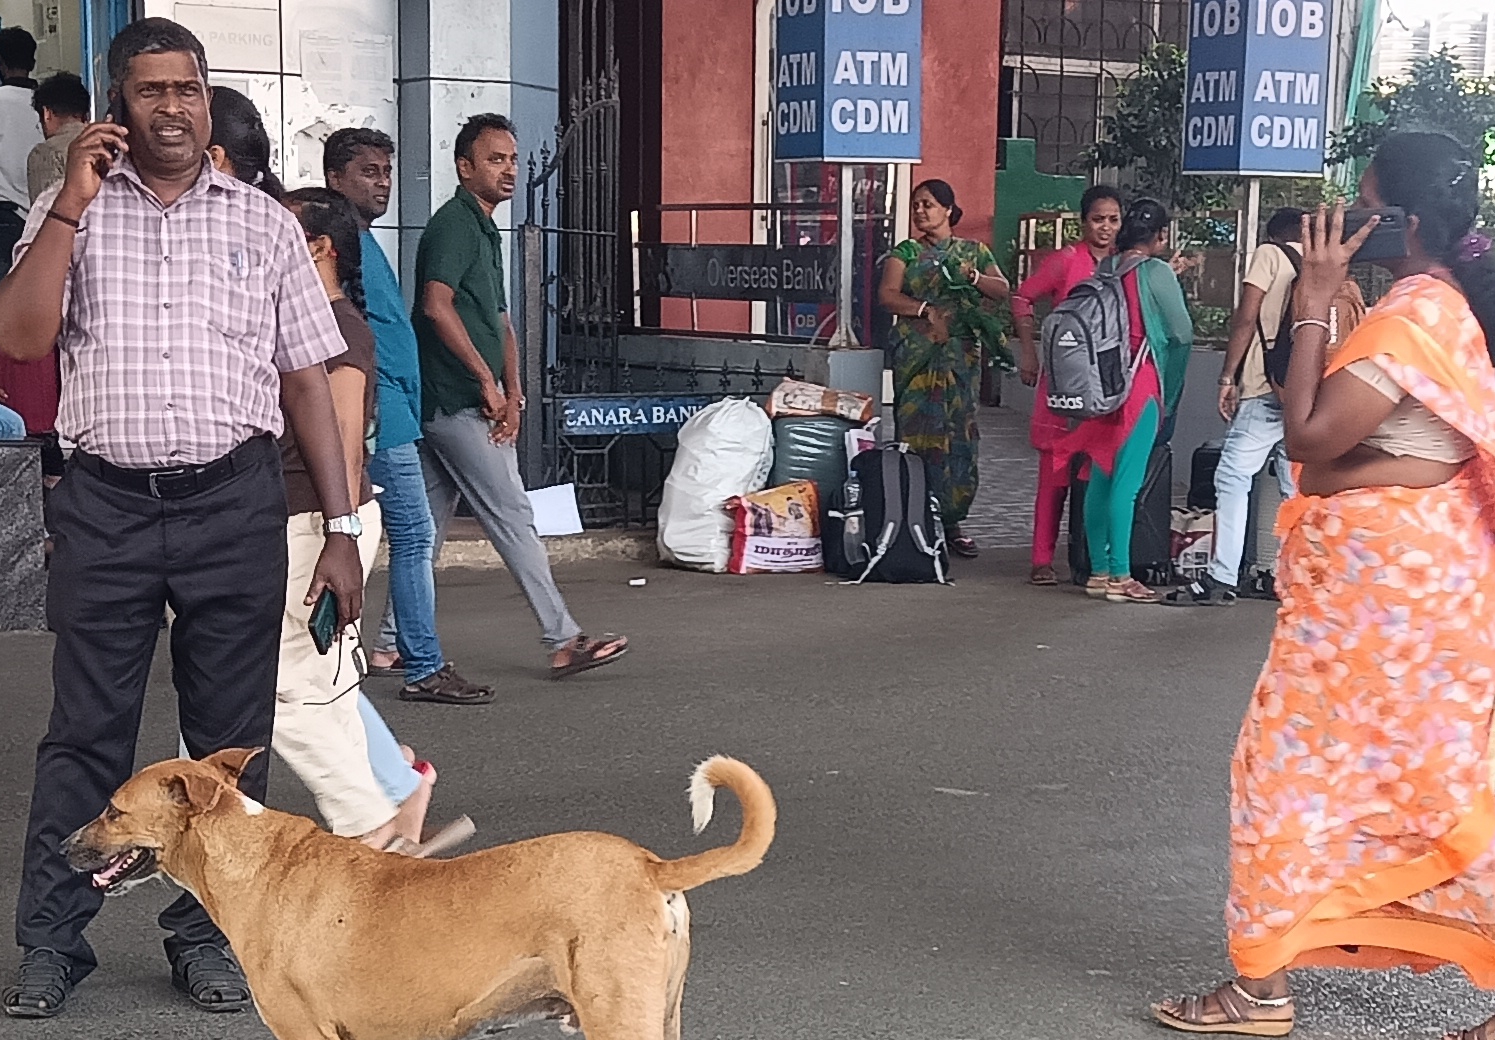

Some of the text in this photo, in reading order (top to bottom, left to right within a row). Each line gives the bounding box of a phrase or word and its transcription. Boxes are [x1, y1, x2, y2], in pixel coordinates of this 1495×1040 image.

[1193, 0, 1240, 37] IOB
[1256, 0, 1324, 38] IOB
[209, 31, 274, 48] PARKING
[778, 52, 816, 87] ATM
[833, 51, 908, 86] ATM
[1190, 70, 1237, 103] ATM
[1254, 70, 1320, 105] ATM
[777, 100, 816, 135] CDM
[831, 98, 909, 134] CDM
[1188, 115, 1235, 148] CDM
[1250, 115, 1318, 149] CDM
[707, 257, 824, 290] Overseas Bank
[564, 407, 649, 427] CANARA
